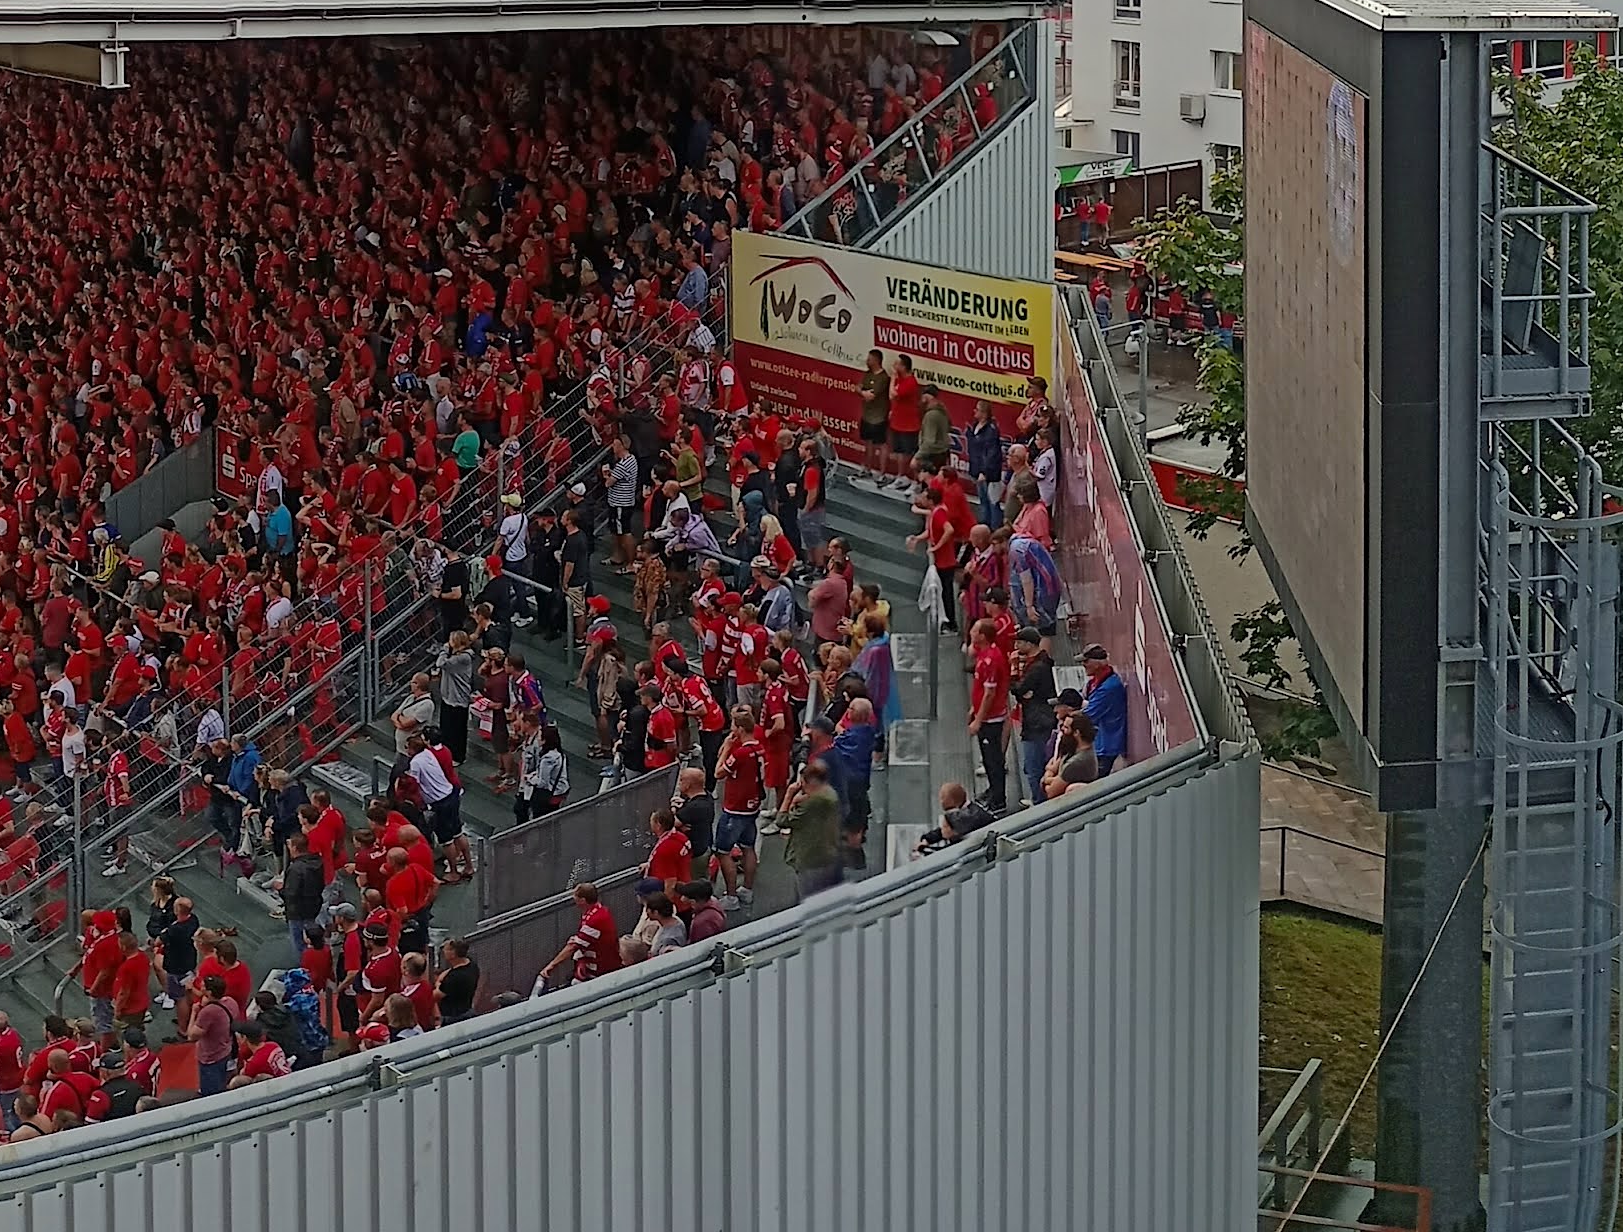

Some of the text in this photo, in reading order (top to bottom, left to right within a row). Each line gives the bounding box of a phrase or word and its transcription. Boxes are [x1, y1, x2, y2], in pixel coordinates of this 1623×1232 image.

[886, 275, 1029, 321] VERÄNDERUNG
[898, 305, 910, 317] DIE
[911, 308, 949, 325] SICHERSTE
[950, 314, 994, 334] KONSTANTE
[876, 323, 1032, 370] wohnen in Cottbus
